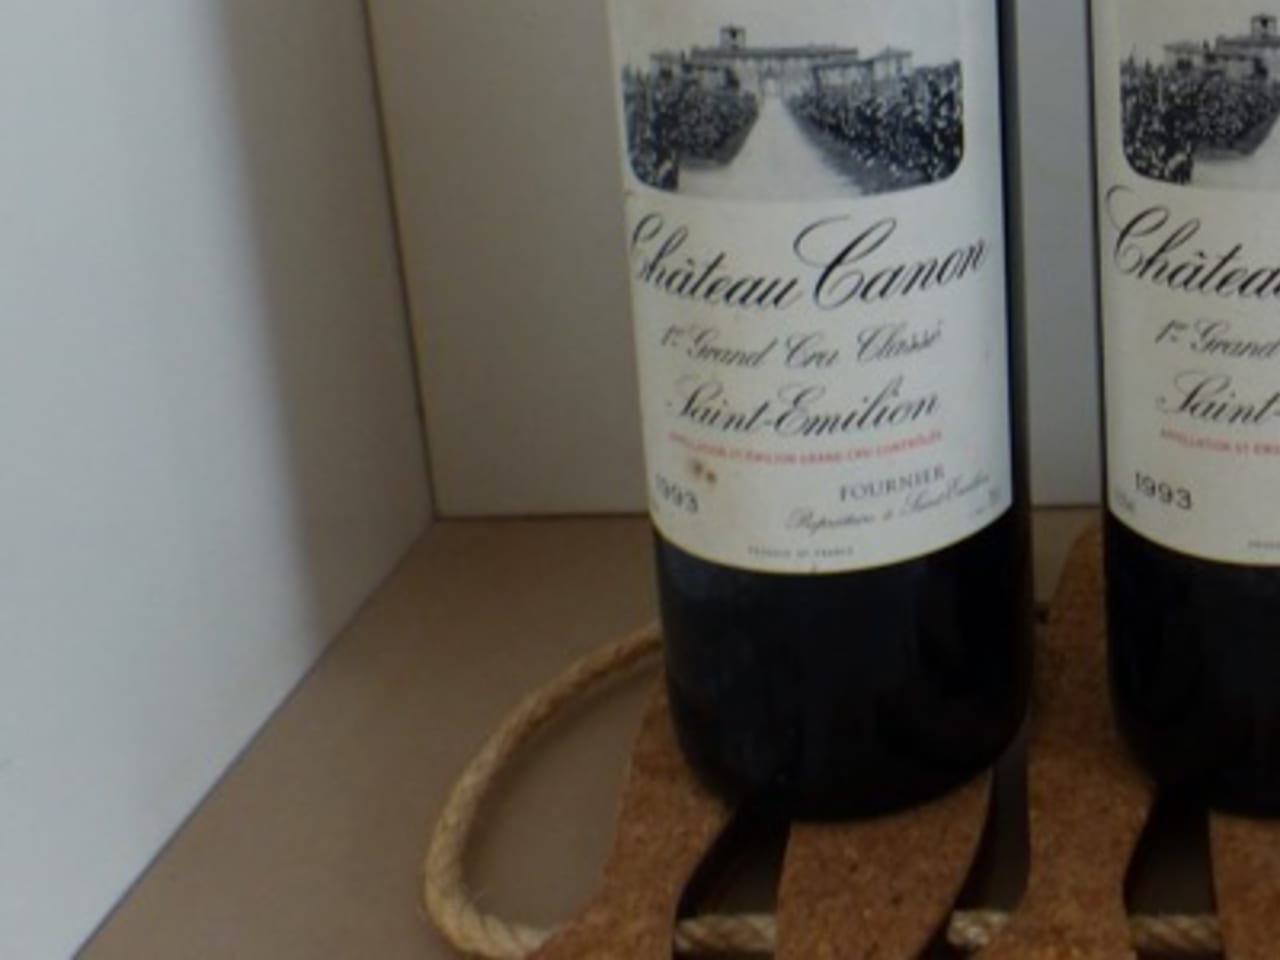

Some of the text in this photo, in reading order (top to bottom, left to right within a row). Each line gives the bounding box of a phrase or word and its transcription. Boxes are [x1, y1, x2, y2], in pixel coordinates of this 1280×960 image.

[792, 214, 988, 311] Canon
[686, 325, 780, 369] Grand
[783, 333, 841, 369] Cru
[838, 463, 946, 503] FOURNIER
[1134, 471, 1193, 511] 1993
